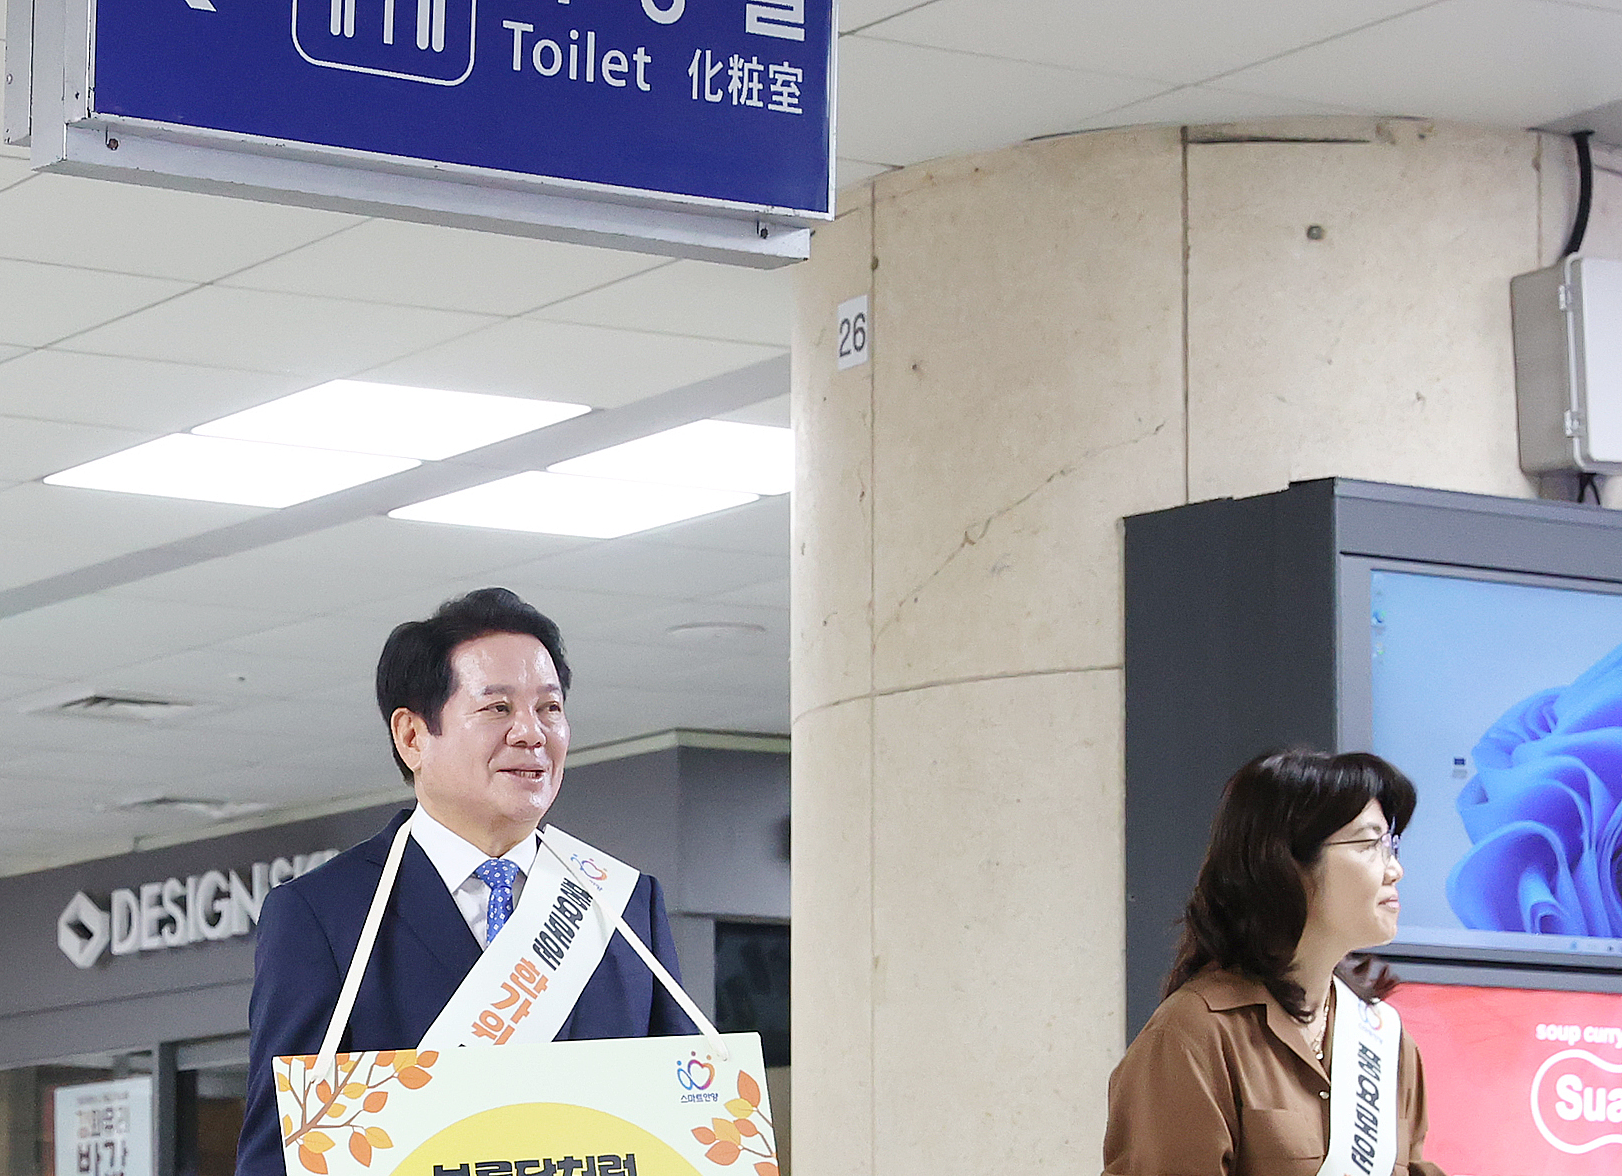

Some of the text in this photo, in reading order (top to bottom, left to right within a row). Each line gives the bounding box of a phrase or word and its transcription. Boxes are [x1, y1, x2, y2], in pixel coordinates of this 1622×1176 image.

[502, 20, 652, 91] Toilet
[687, 48, 803, 114] 化粧室
[838, 313, 866, 357] 26
[471, 957, 550, 1046] 한가위
[1536, 1024, 1581, 1046] soup
[680, 1092, 719, 1104] 스마트안양
